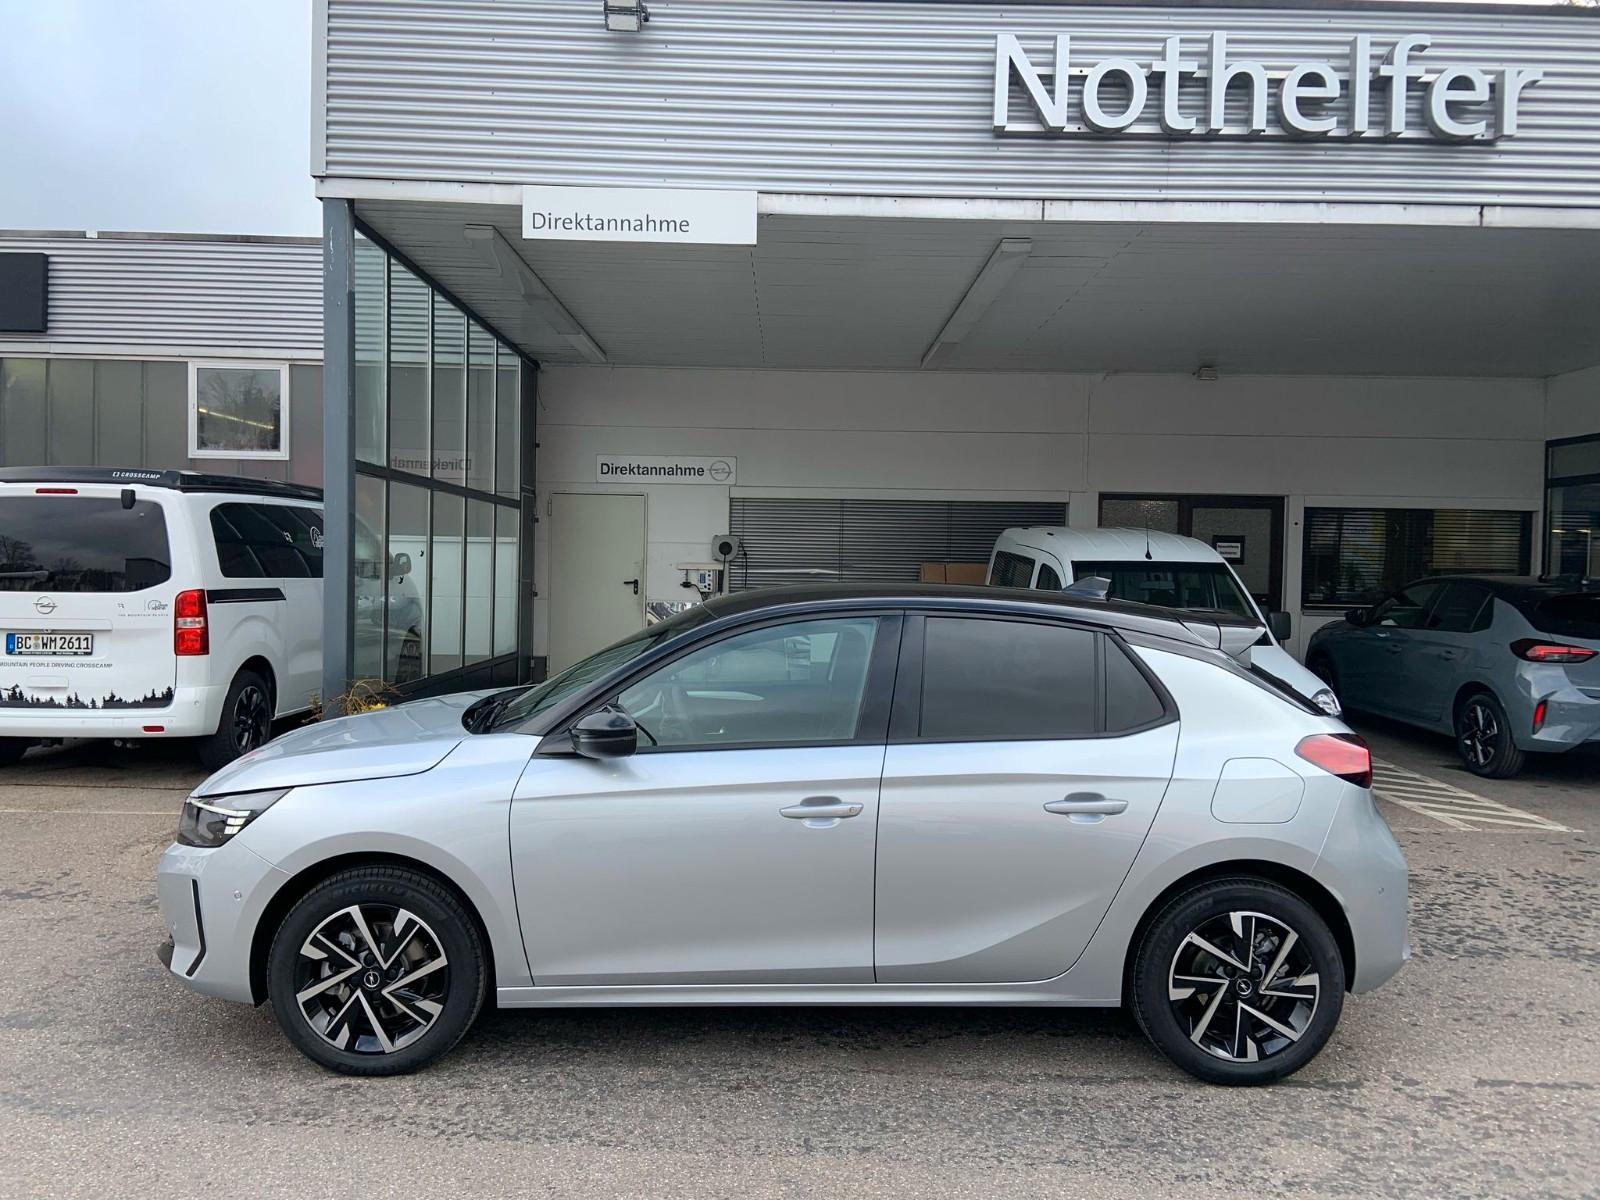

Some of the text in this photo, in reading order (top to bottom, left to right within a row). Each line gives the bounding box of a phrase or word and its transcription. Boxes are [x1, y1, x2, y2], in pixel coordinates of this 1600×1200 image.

[993, 31, 1543, 138] Nothelfer
[532, 212, 690, 233] Direktannahme
[600, 463, 705, 476] Direktannahme
[16, 636, 90, 650] BC WM 2611
